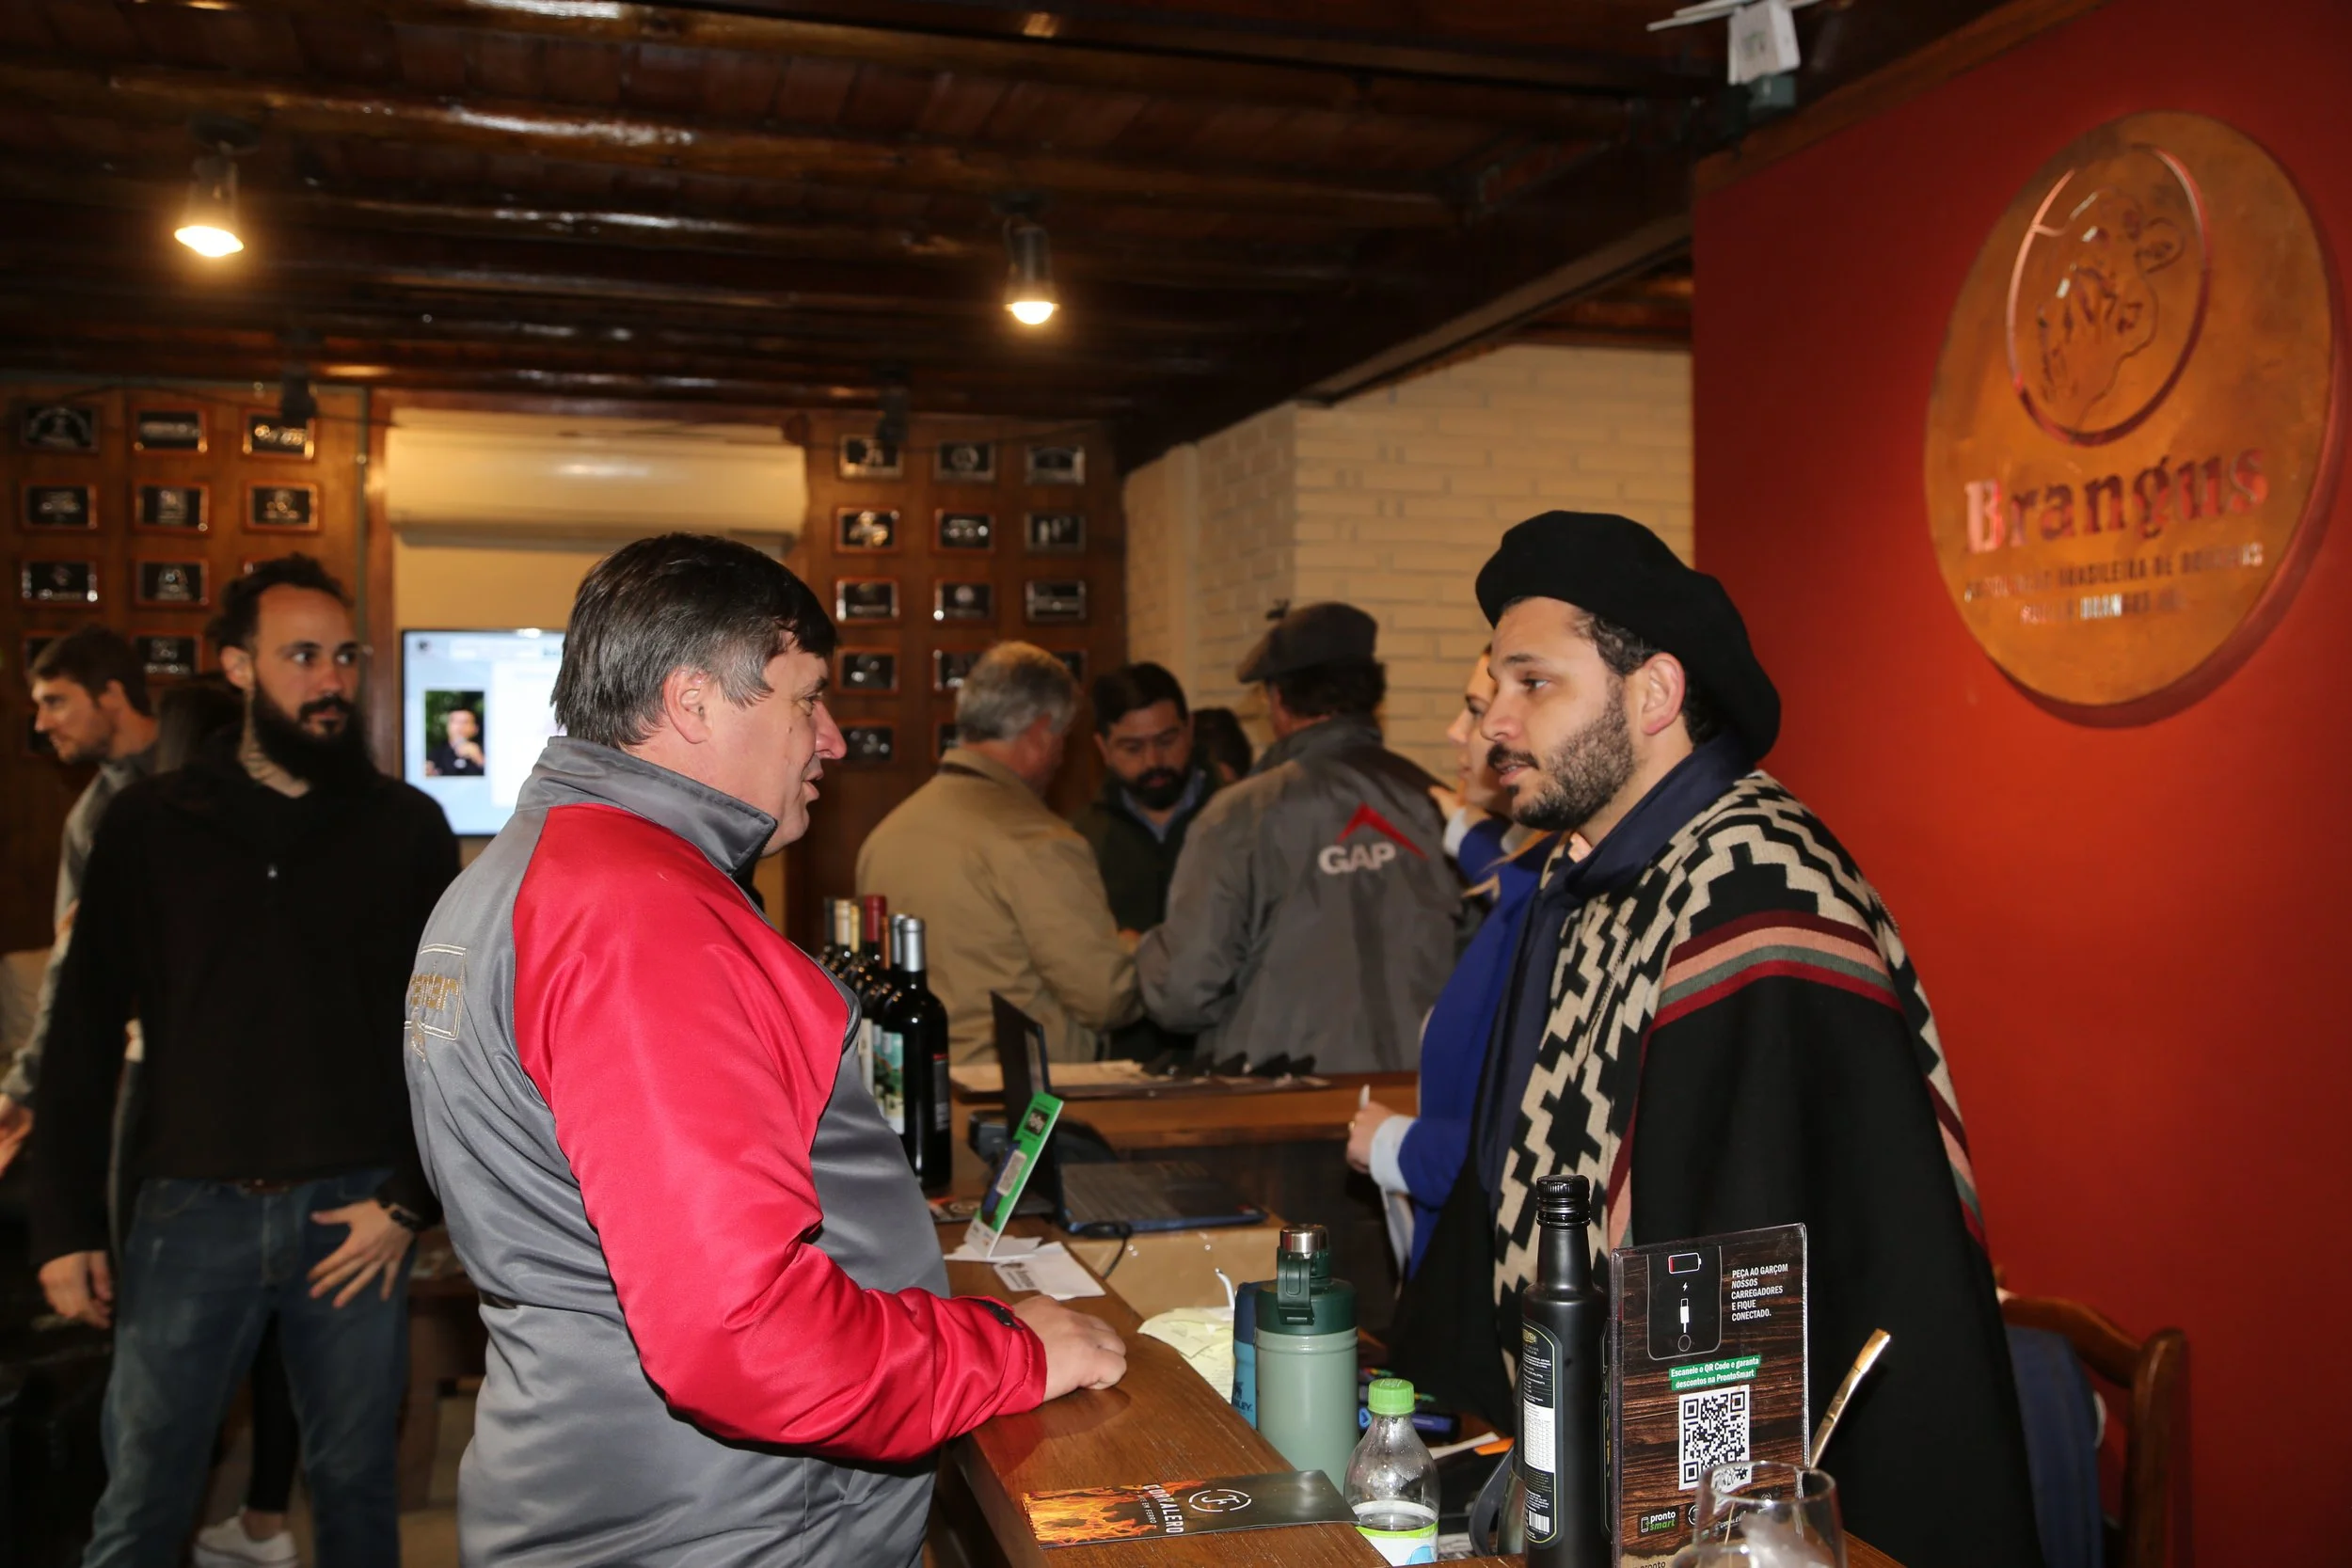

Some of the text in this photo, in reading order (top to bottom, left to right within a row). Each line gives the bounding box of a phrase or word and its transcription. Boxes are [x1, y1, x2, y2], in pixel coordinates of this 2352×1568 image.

[1963, 448, 2269, 553] Brangus
[1317, 841, 1397, 875] GAP
[1732, 1263, 1788, 1279] PEÇA AO GARÇOM
[1731, 1277, 1758, 1290] NOSSOS
[1731, 1285, 1784, 1300] CARREGADORES
[1731, 1300, 1756, 1311] E FIQUE
[1731, 1308, 1772, 1322] CONECTADO.
[1671, 1366, 1698, 1378] Escaneie
[1704, 1363, 1714, 1372] QR
[1714, 1361, 1730, 1370] Code
[1736, 1357, 1759, 1370] garanta
[1676, 1369, 1755, 1389] descontos na ProntoSmart
[1142, 1483, 1184, 1533] CORRALERO
[1649, 1519, 1676, 1531] smart
[1650, 1511, 1677, 1524] pronto
